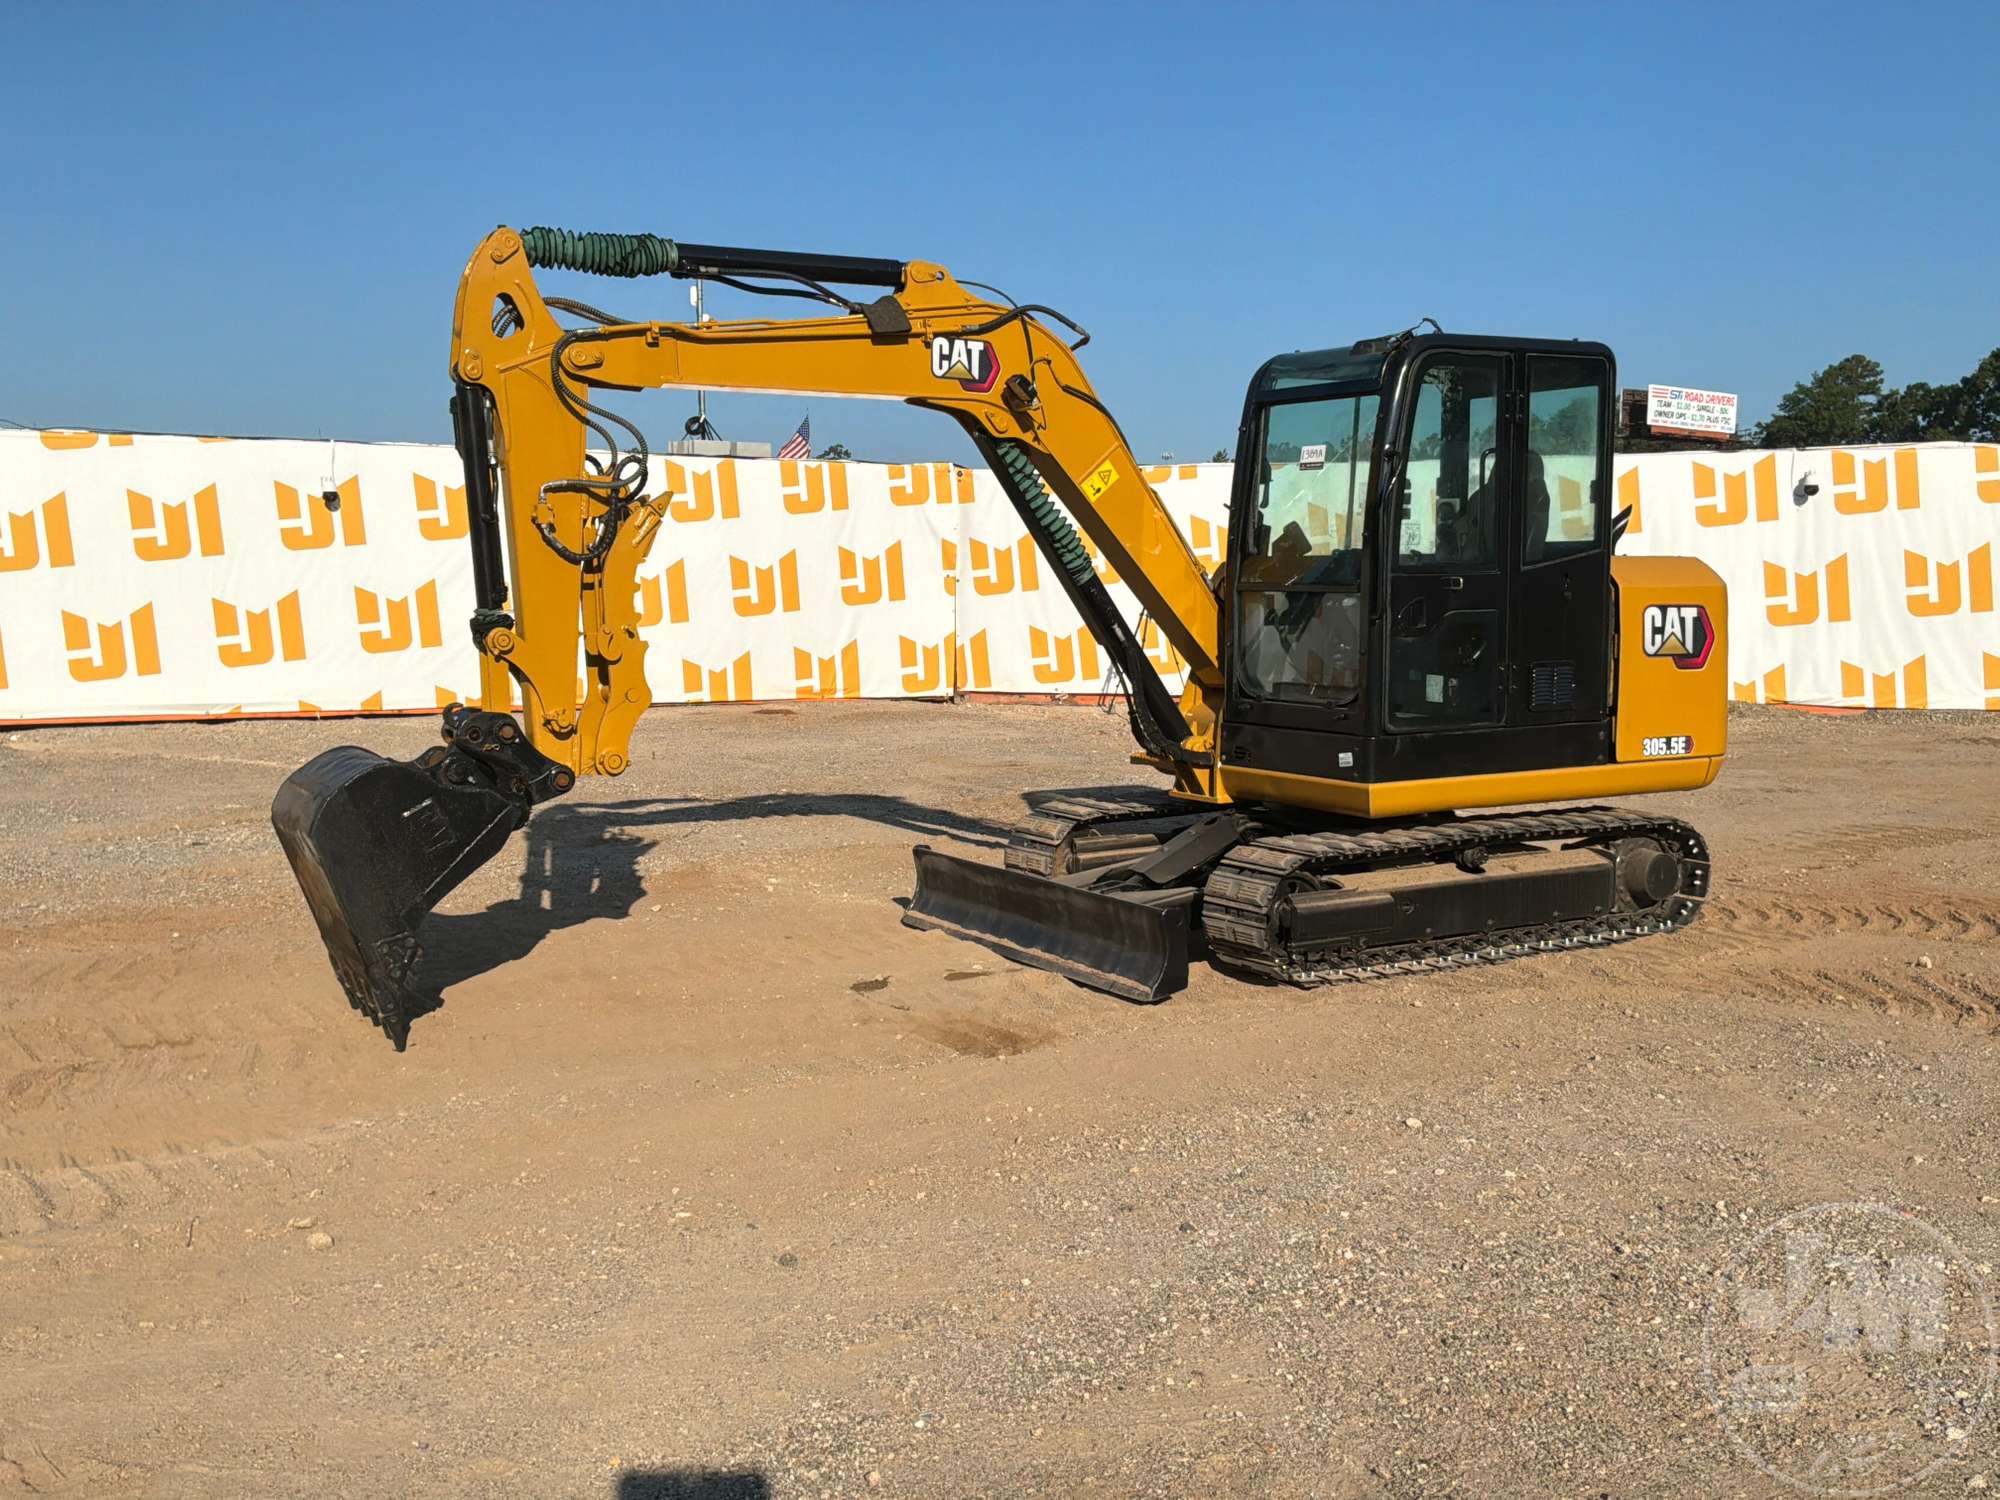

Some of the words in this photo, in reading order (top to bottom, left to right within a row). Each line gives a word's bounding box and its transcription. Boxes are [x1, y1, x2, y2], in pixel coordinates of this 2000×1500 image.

[932, 336, 984, 380] CAT
[1644, 606, 1698, 655] CAT
[1643, 736, 1686, 756] 305.5E
